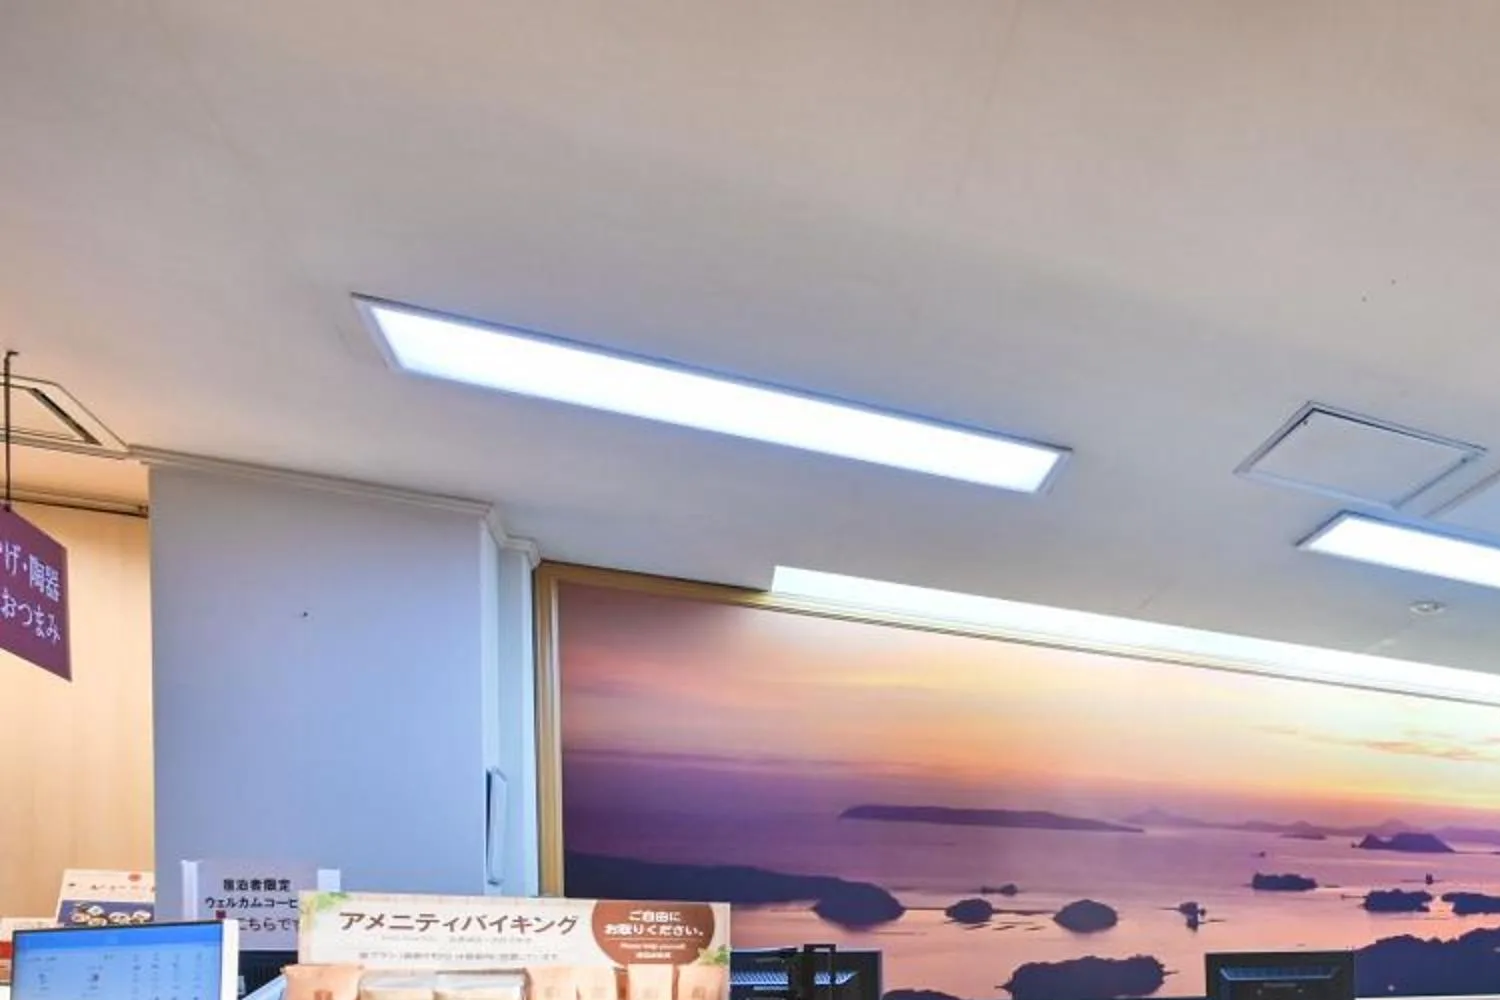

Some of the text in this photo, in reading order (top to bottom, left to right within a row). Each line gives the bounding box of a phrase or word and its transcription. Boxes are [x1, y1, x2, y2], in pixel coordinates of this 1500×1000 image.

[0, 541, 60, 603] げ・陶器
[0, 587, 61, 645] おつまみ
[223, 878, 292, 893] 宿泊者限定
[339, 911, 579, 935] アメニティバイキング
[628, 910, 682, 923] ご自由に
[604, 924, 704, 937] お取りください。
